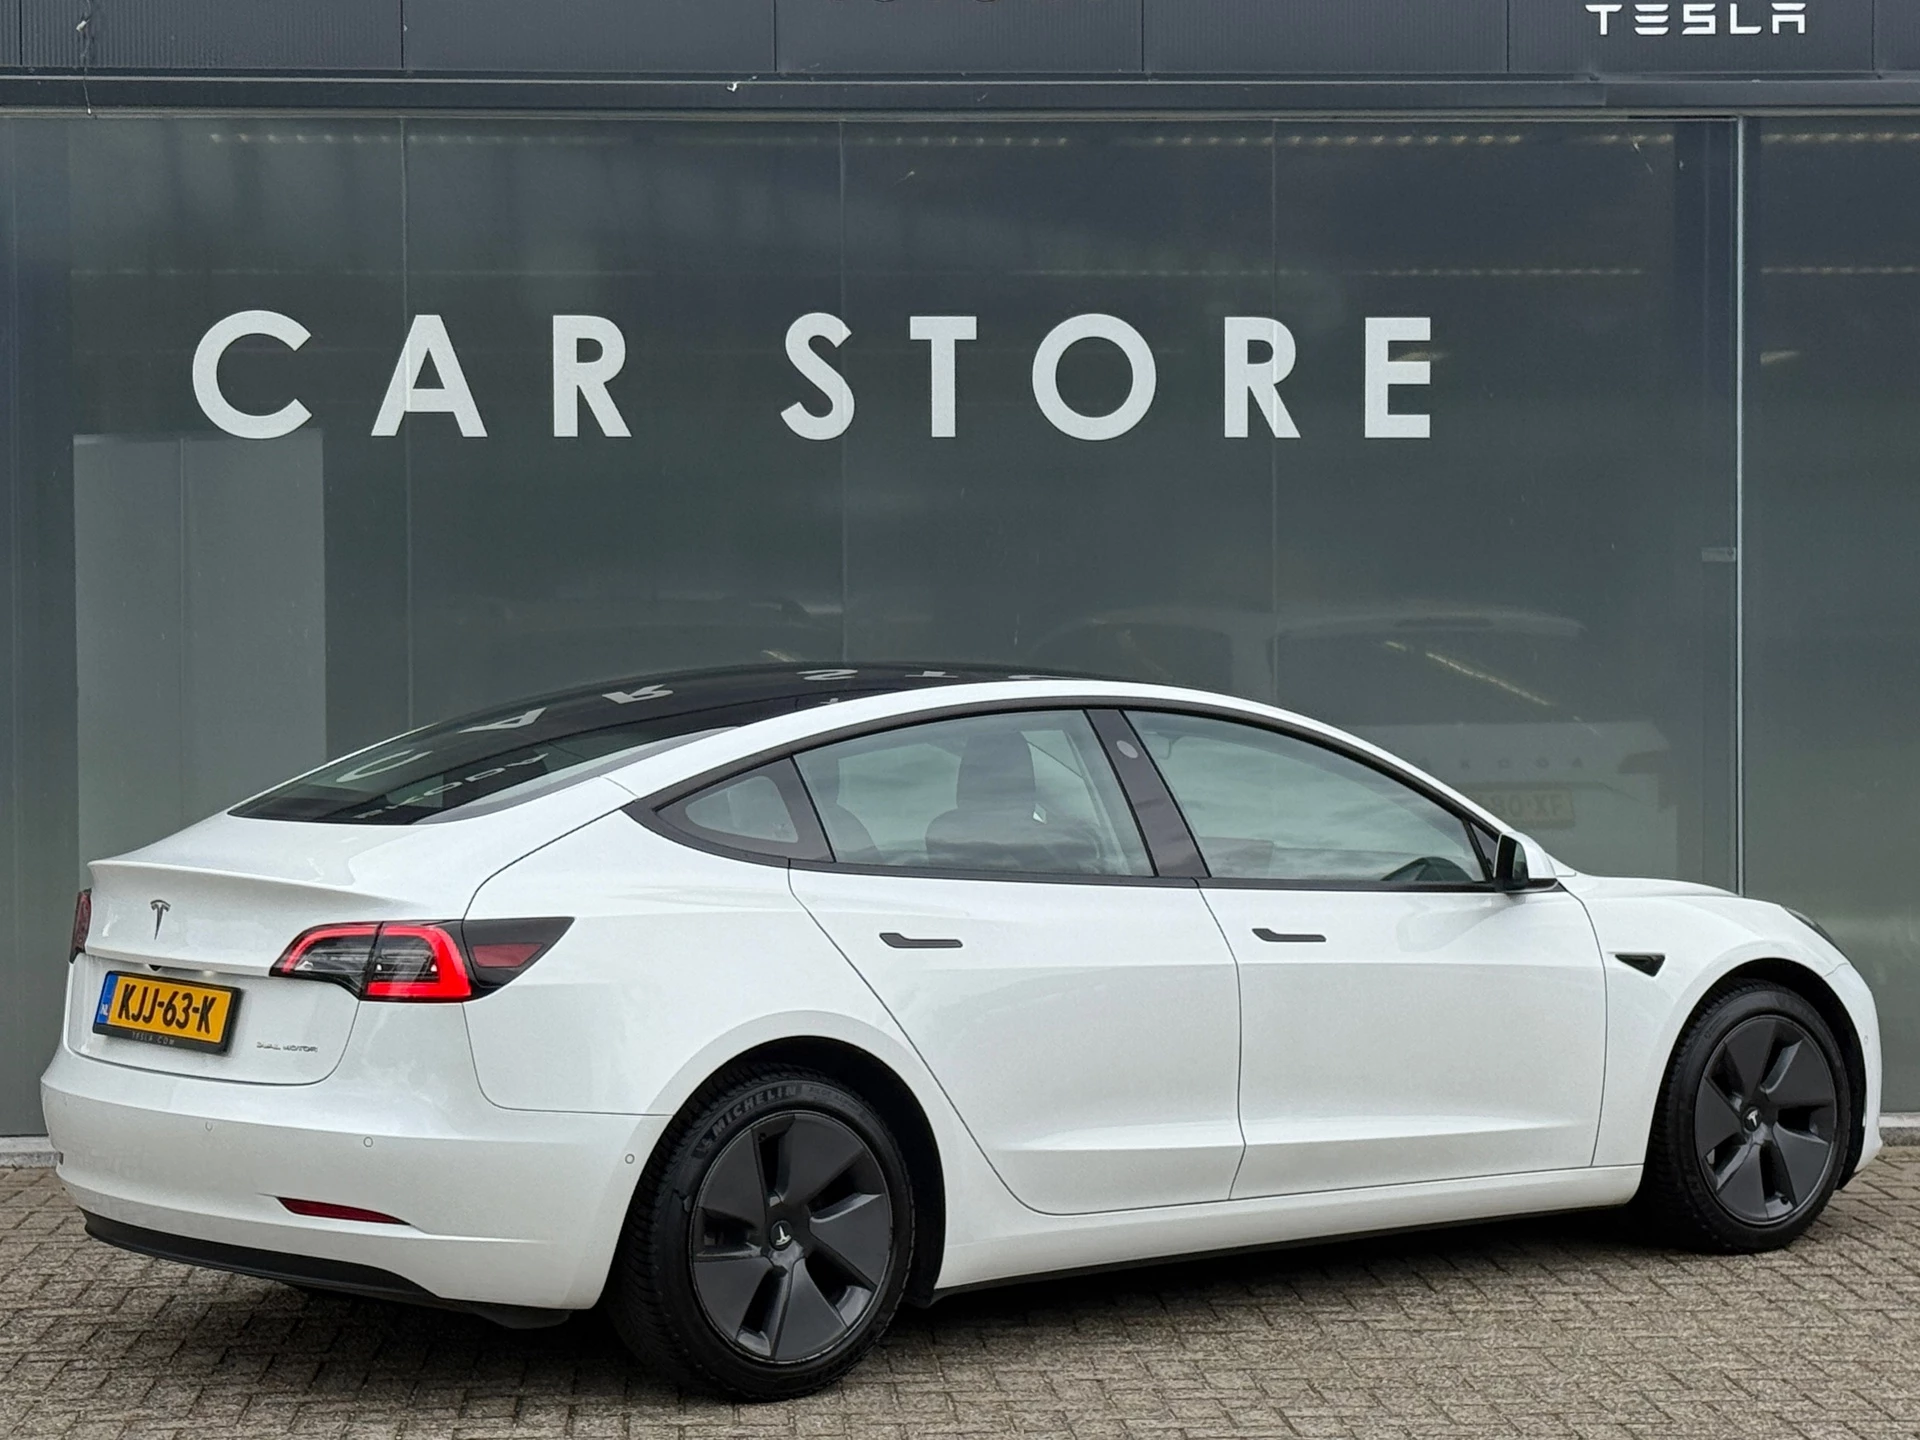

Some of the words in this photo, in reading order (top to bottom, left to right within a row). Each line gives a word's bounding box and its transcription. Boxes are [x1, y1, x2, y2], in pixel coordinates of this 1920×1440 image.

[1585, 3, 1806, 36] TESLA
[192, 309, 632, 440] CAR
[780, 311, 1431, 441] STORE
[117, 983, 217, 1035] KJJ-63-K
[711, 1085, 797, 1137] MICHELIN
